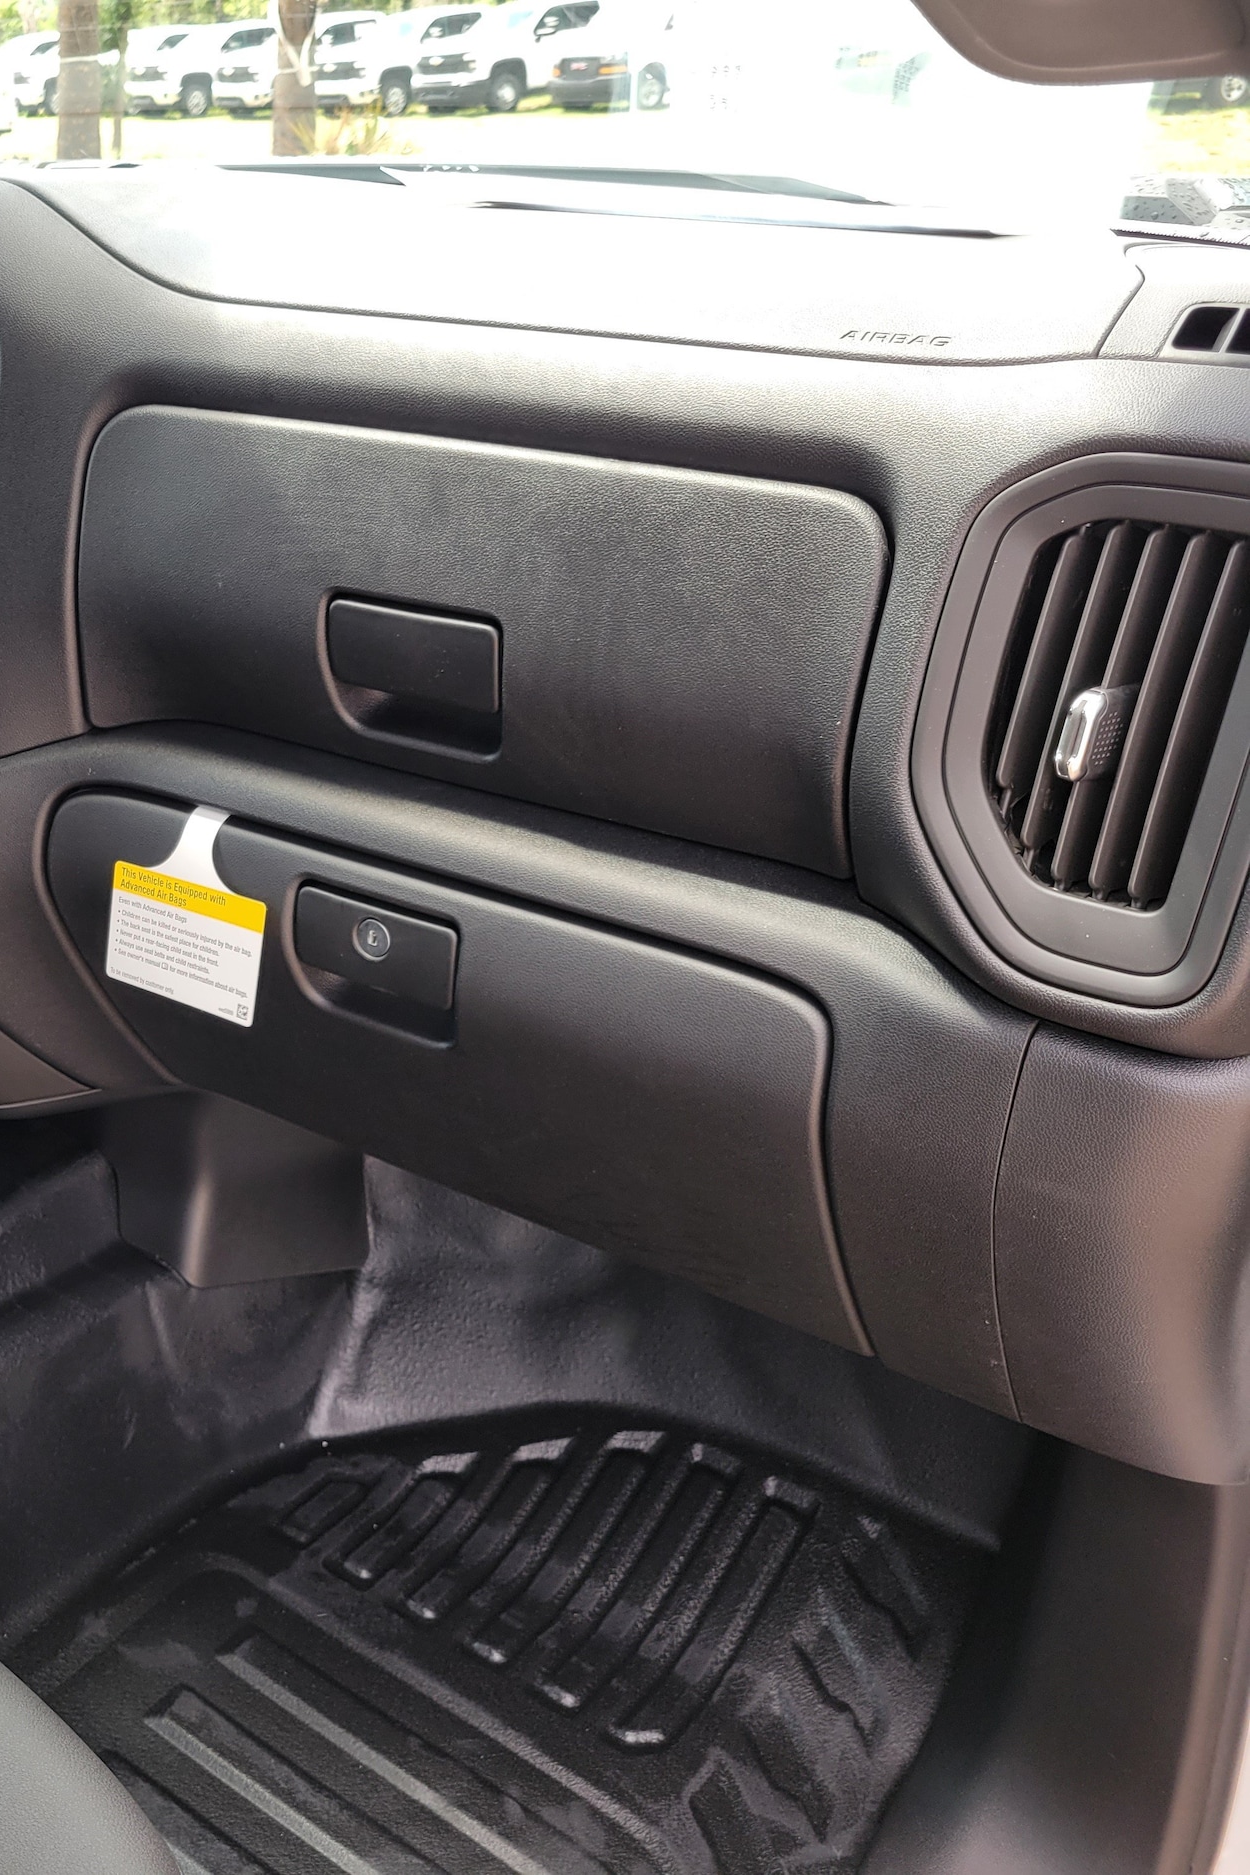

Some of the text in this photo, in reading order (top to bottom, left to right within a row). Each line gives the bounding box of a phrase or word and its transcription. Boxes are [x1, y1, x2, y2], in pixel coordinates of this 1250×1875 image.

[840, 330, 951, 346] AIRBAG
[121, 879, 187, 907] Advanced Air Bags
[122, 867, 226, 906] This Vehicle is Equipped with
[118, 896, 130, 905] Even
[131, 900, 142, 908] with
[143, 904, 166, 917] Advanced
[175, 914, 187, 924] Bags
[120, 929, 132, 938] Never
[145, 938, 169, 951] rear-facing
[170, 946, 181, 954] child
[182, 950, 192, 958] seat
[198, 954, 206, 962] the
[207, 957, 219, 967] front.
[121, 910, 140, 920] Children
[158, 921, 170, 930] killed
[178, 928, 199, 940] seriously
[200, 934, 217, 945] injured
[218, 940, 224, 949] by
[225, 942, 233, 950] the
[241, 948, 252, 957] bag.
[121, 919, 129, 927] The
[130, 922, 140, 930] back
[165, 934, 178, 943] safest
[179, 938, 191, 947] place
[199, 945, 219, 956] children.
[118, 948, 126, 956] See
[127, 952, 143, 962] owner's
[145, 958, 160, 967] manual
[176, 969, 187, 977] more
[189, 972, 214, 986] information
[215, 981, 228, 992] about
[235, 988, 248, 998] bags.
[119, 938, 134, 949] Always
[144, 947, 153, 955] seat
[154, 951, 165, 959] belts
[175, 958, 187, 966] child
[187, 961, 209, 974] restraints.
